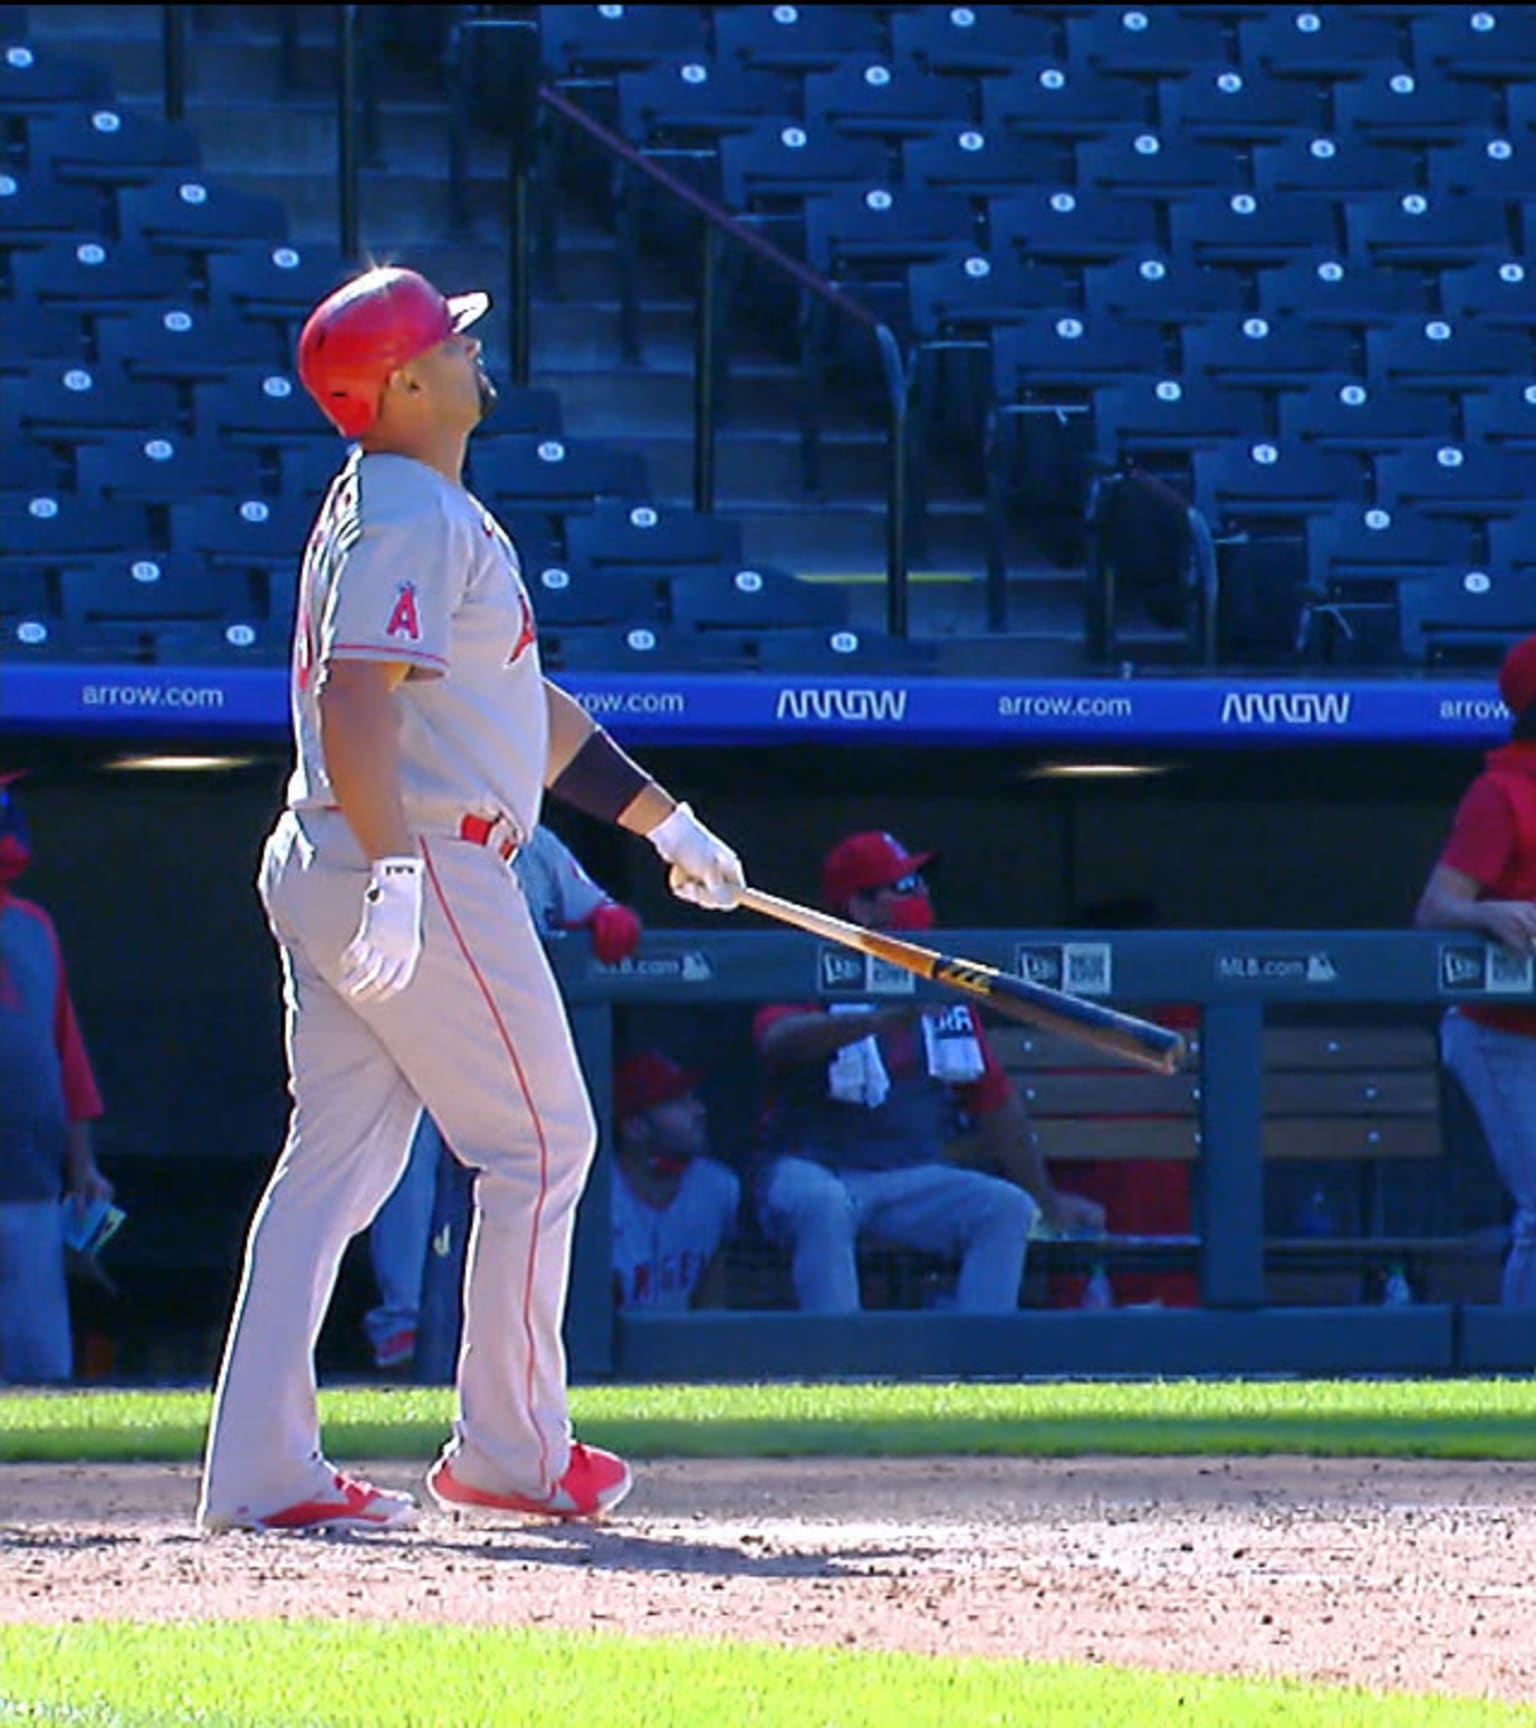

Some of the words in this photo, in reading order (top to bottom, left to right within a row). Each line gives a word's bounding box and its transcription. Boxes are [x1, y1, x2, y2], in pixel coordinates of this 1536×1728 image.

[82, 686, 224, 707] arrow.com
[574, 692, 685, 713] row.com
[775, 690, 907, 720] ARROW
[997, 696, 1132, 717] arrow.com
[1221, 693, 1350, 723] ARROW
[1439, 699, 1511, 720] arrow
[1220, 957, 1304, 977] MLB.com
